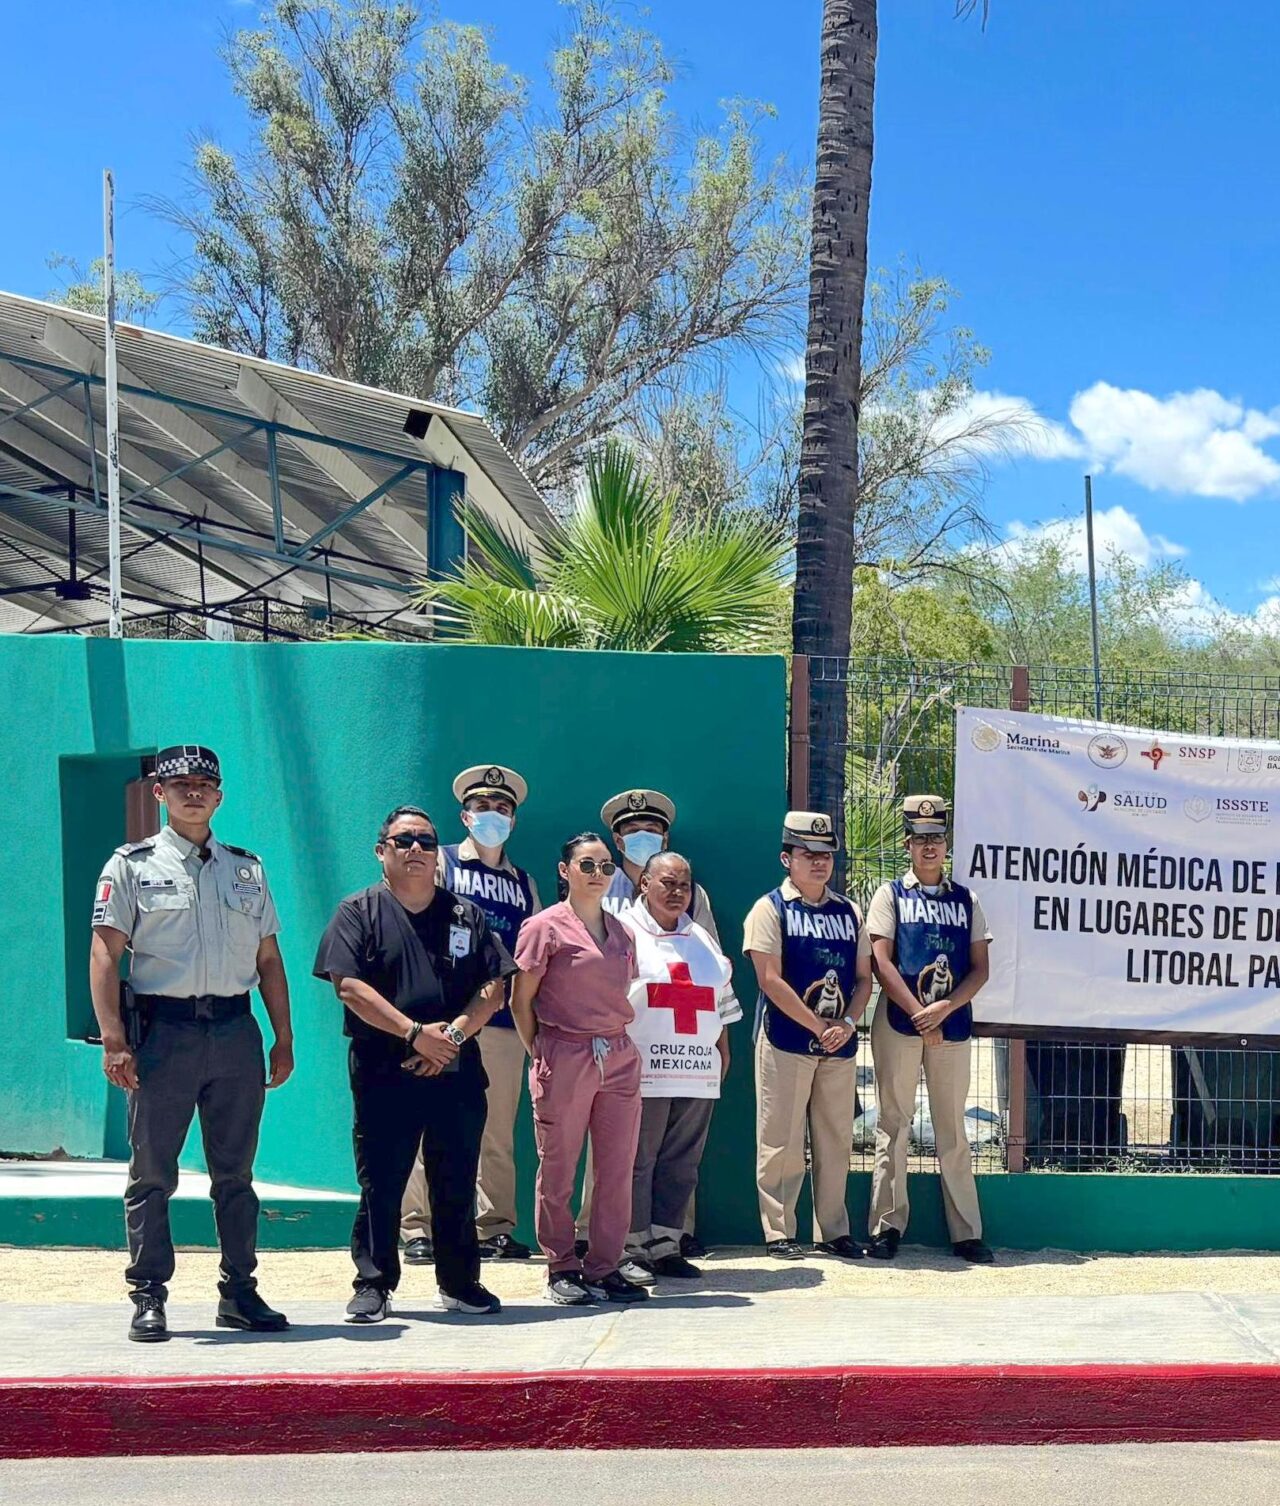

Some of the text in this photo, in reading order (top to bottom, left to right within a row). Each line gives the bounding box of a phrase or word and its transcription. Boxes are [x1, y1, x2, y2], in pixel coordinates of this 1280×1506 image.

[1007, 733, 1060, 748] Marina
[1179, 746, 1216, 759] SNSP
[1114, 794, 1167, 809] SALUD
[1216, 798, 1269, 812] ISSSTE
[968, 842, 1108, 886] ATENCIÓN
[1117, 847, 1222, 892] MÉDICA
[1232, 860, 1267, 894] DE
[454, 867, 527, 912] MARINA
[786, 908, 856, 942] MARINA
[898, 897, 968, 930] MARINA
[1034, 896, 1070, 932] EN
[1079, 898, 1205, 938] LUGARES
[1213, 905, 1248, 941] DE
[1126, 948, 1240, 988] LITORAL
[650, 1044, 712, 1056] CRUZ ROJA
[650, 1058, 712, 1070] MEXICANA
